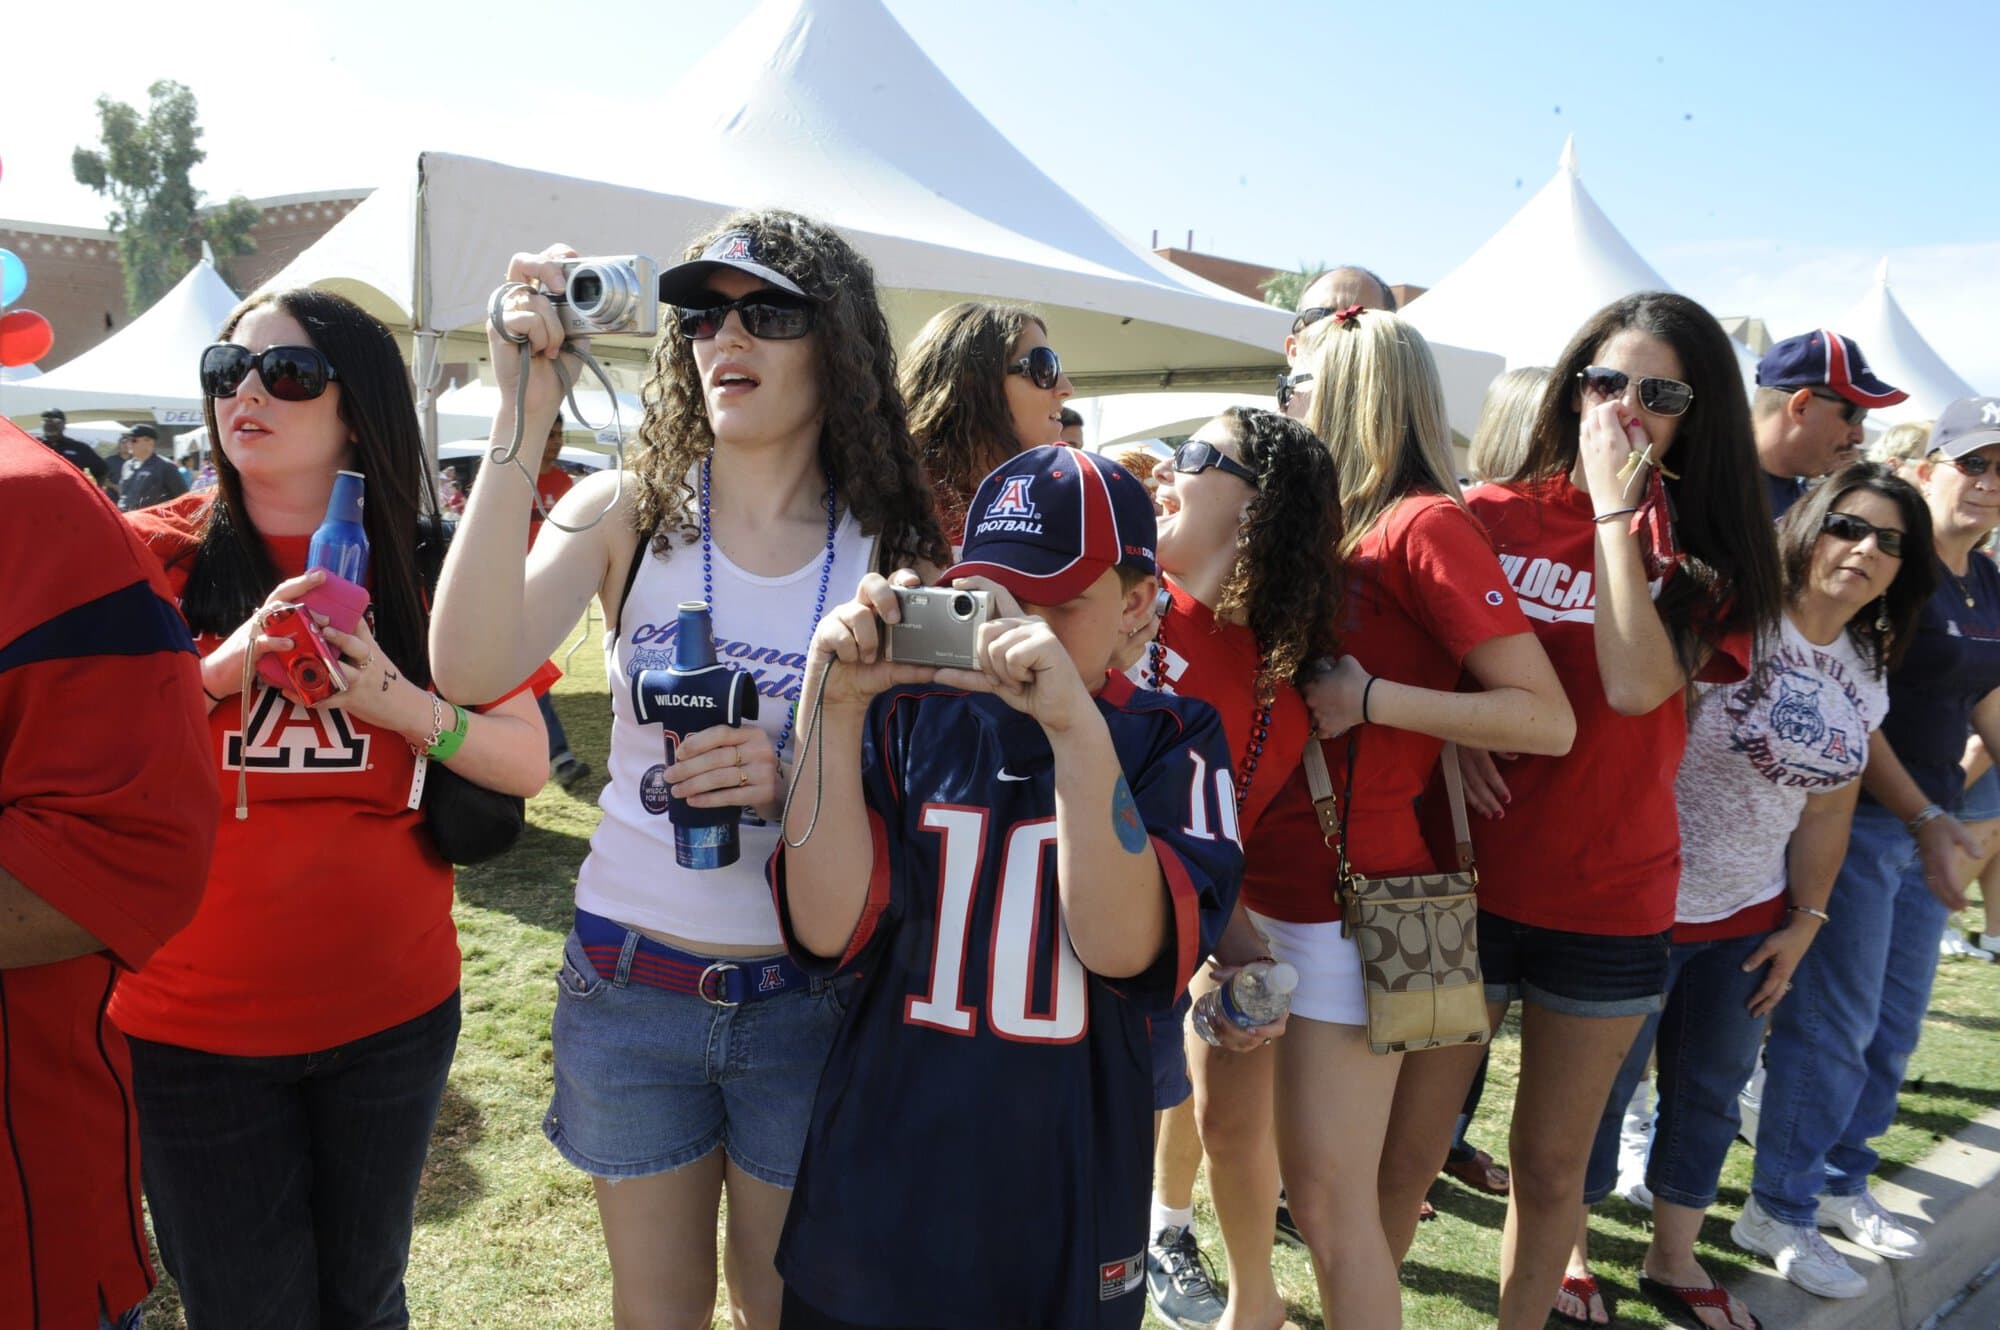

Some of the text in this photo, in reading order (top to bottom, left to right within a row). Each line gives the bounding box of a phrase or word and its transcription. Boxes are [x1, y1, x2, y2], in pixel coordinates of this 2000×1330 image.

[722, 237, 754, 260] A
[984, 475, 1035, 520] A
[975, 520, 1043, 537] FOOTBALL
[655, 694, 714, 709] WILDCATS
[222, 686, 371, 773] A
[1821, 728, 1850, 764] A
[1744, 735, 1788, 784] BEAR
[904, 802, 1088, 1046] 10
[759, 965, 785, 992] A
